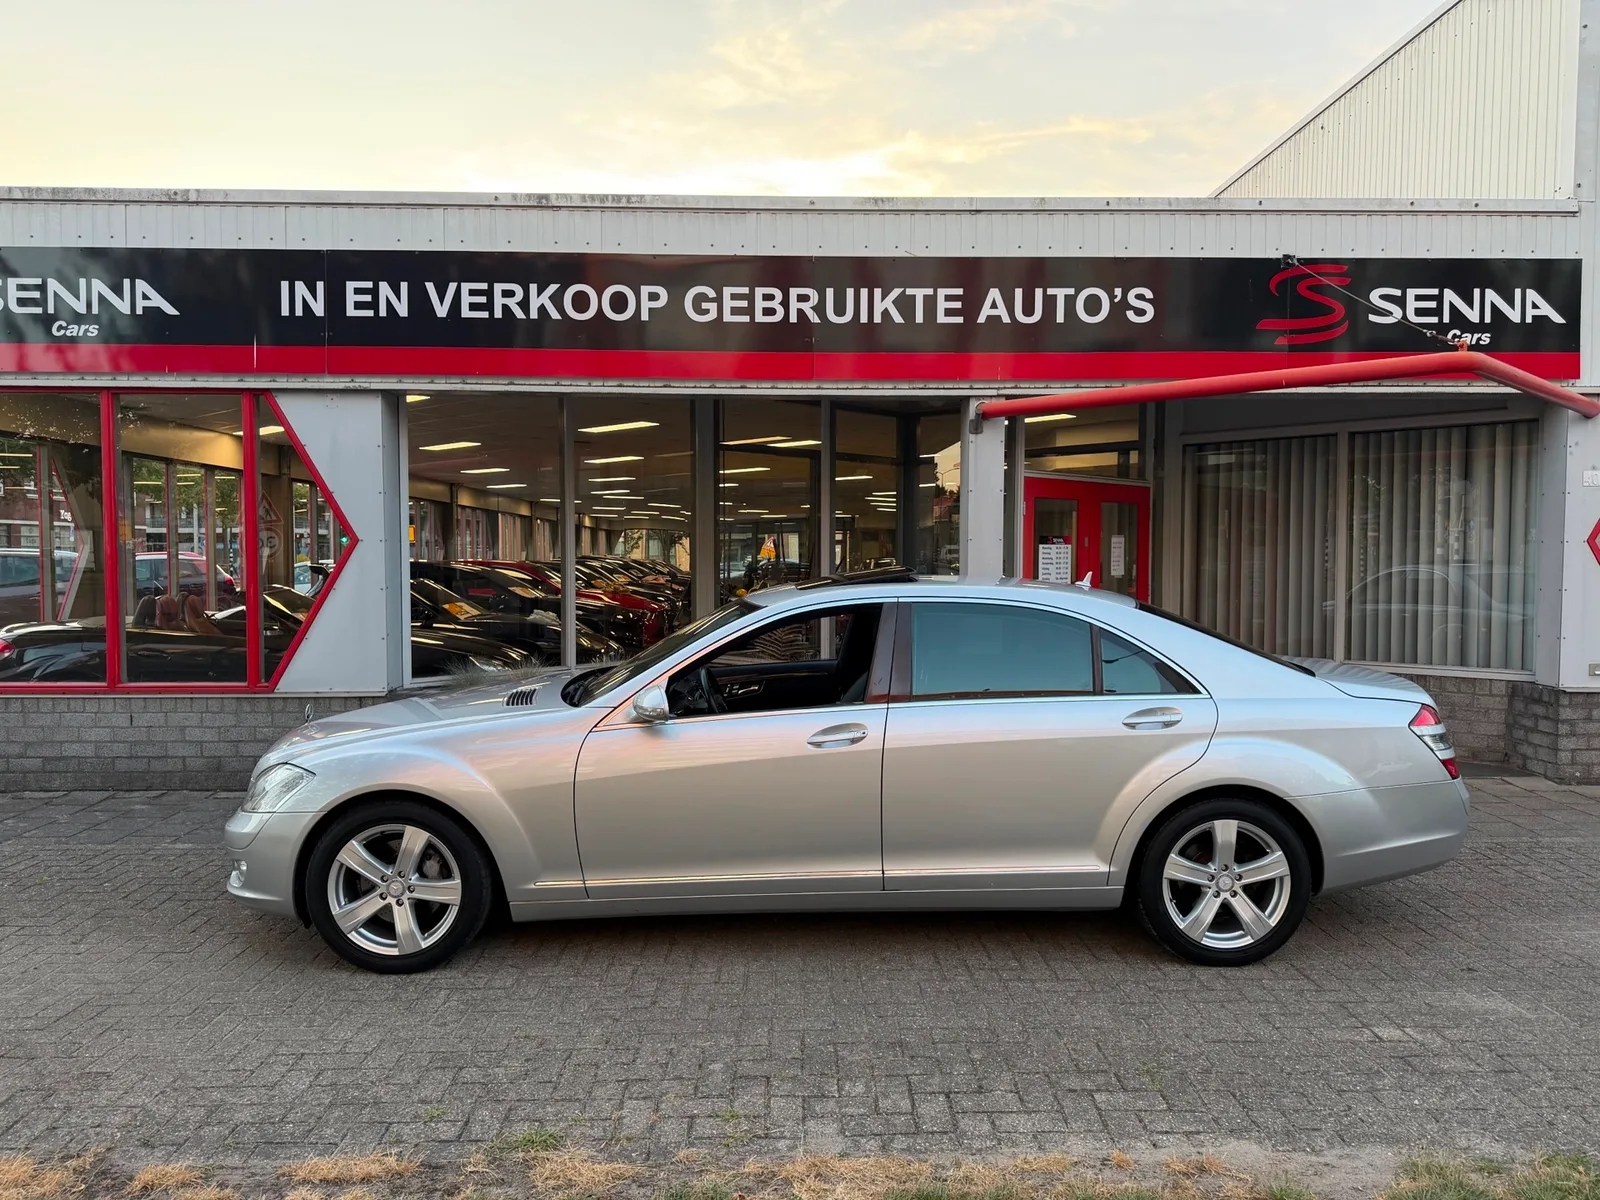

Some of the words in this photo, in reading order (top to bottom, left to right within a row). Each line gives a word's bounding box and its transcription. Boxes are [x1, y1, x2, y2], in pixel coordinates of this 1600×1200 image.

[0, 277, 180, 315] ENNA
[280, 280, 325, 316] IN
[345, 281, 408, 317] EN
[425, 282, 668, 322] VERKOOP
[684, 285, 964, 324] GEBRUIKTE
[976, 286, 1155, 324] AUTO’S
[1368, 287, 1567, 324] SENNA
[51, 320, 99, 337] Cars
[1446, 328, 1491, 345] Cars
